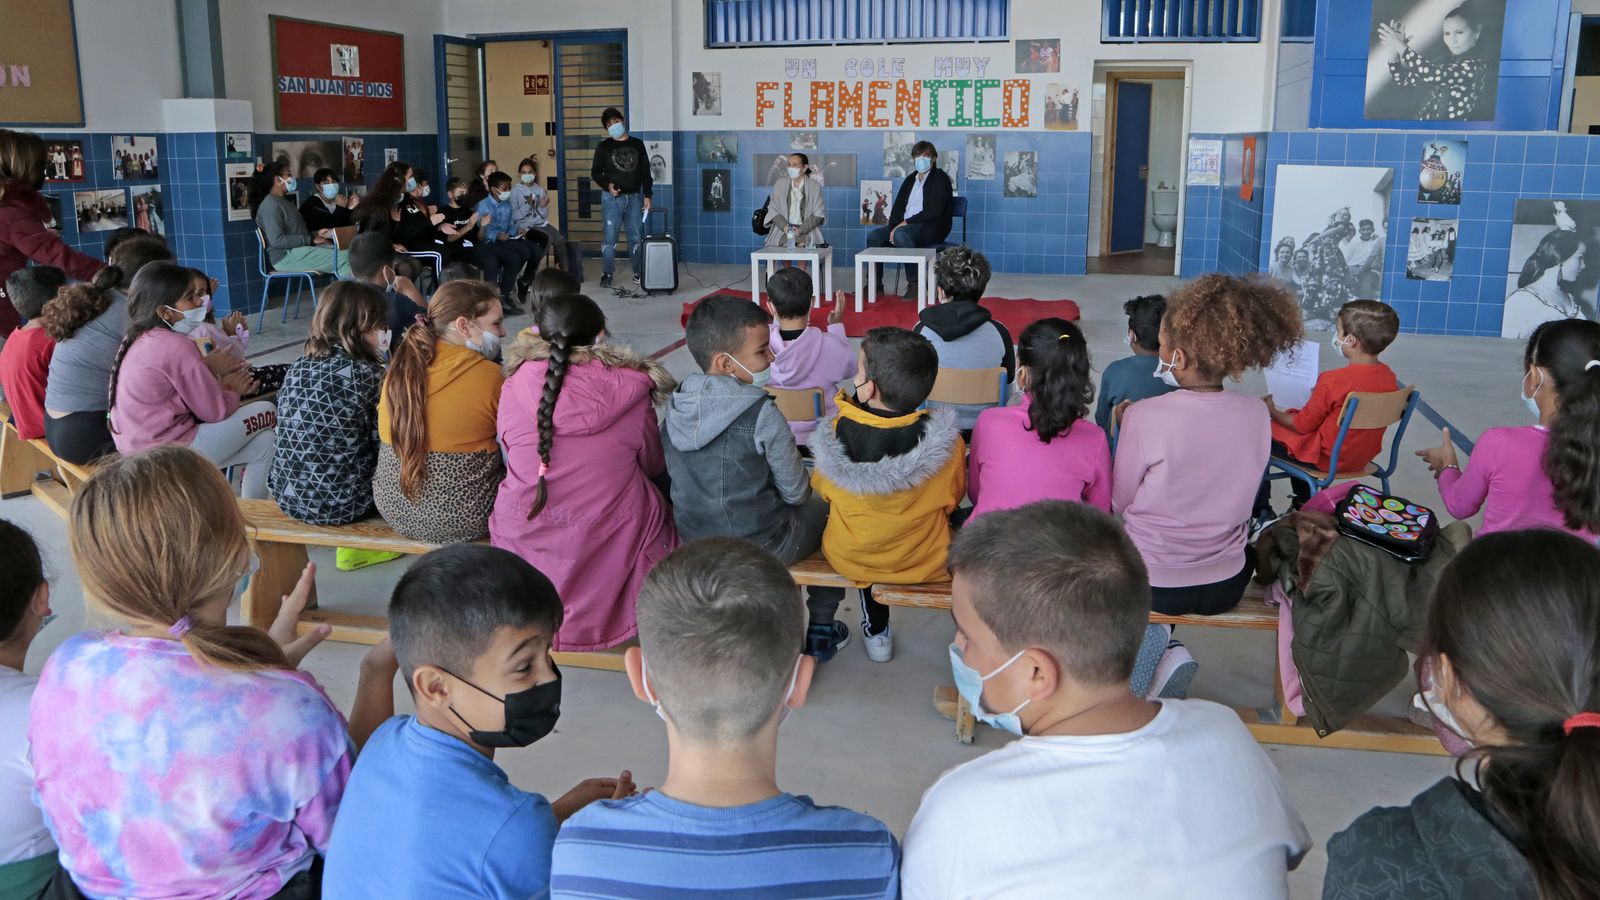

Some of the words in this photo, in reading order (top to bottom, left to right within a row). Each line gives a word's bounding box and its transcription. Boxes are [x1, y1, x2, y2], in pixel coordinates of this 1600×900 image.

[785, 58, 817, 79] UN
[845, 57, 906, 78] COLE
[934, 56, 990, 78] MUY
[278, 76, 306, 93] SAN
[310, 79, 345, 95] JUAN
[349, 82, 364, 96] DE
[366, 83, 392, 97] DIOS
[755, 79, 1030, 128] FLAMENTICO
